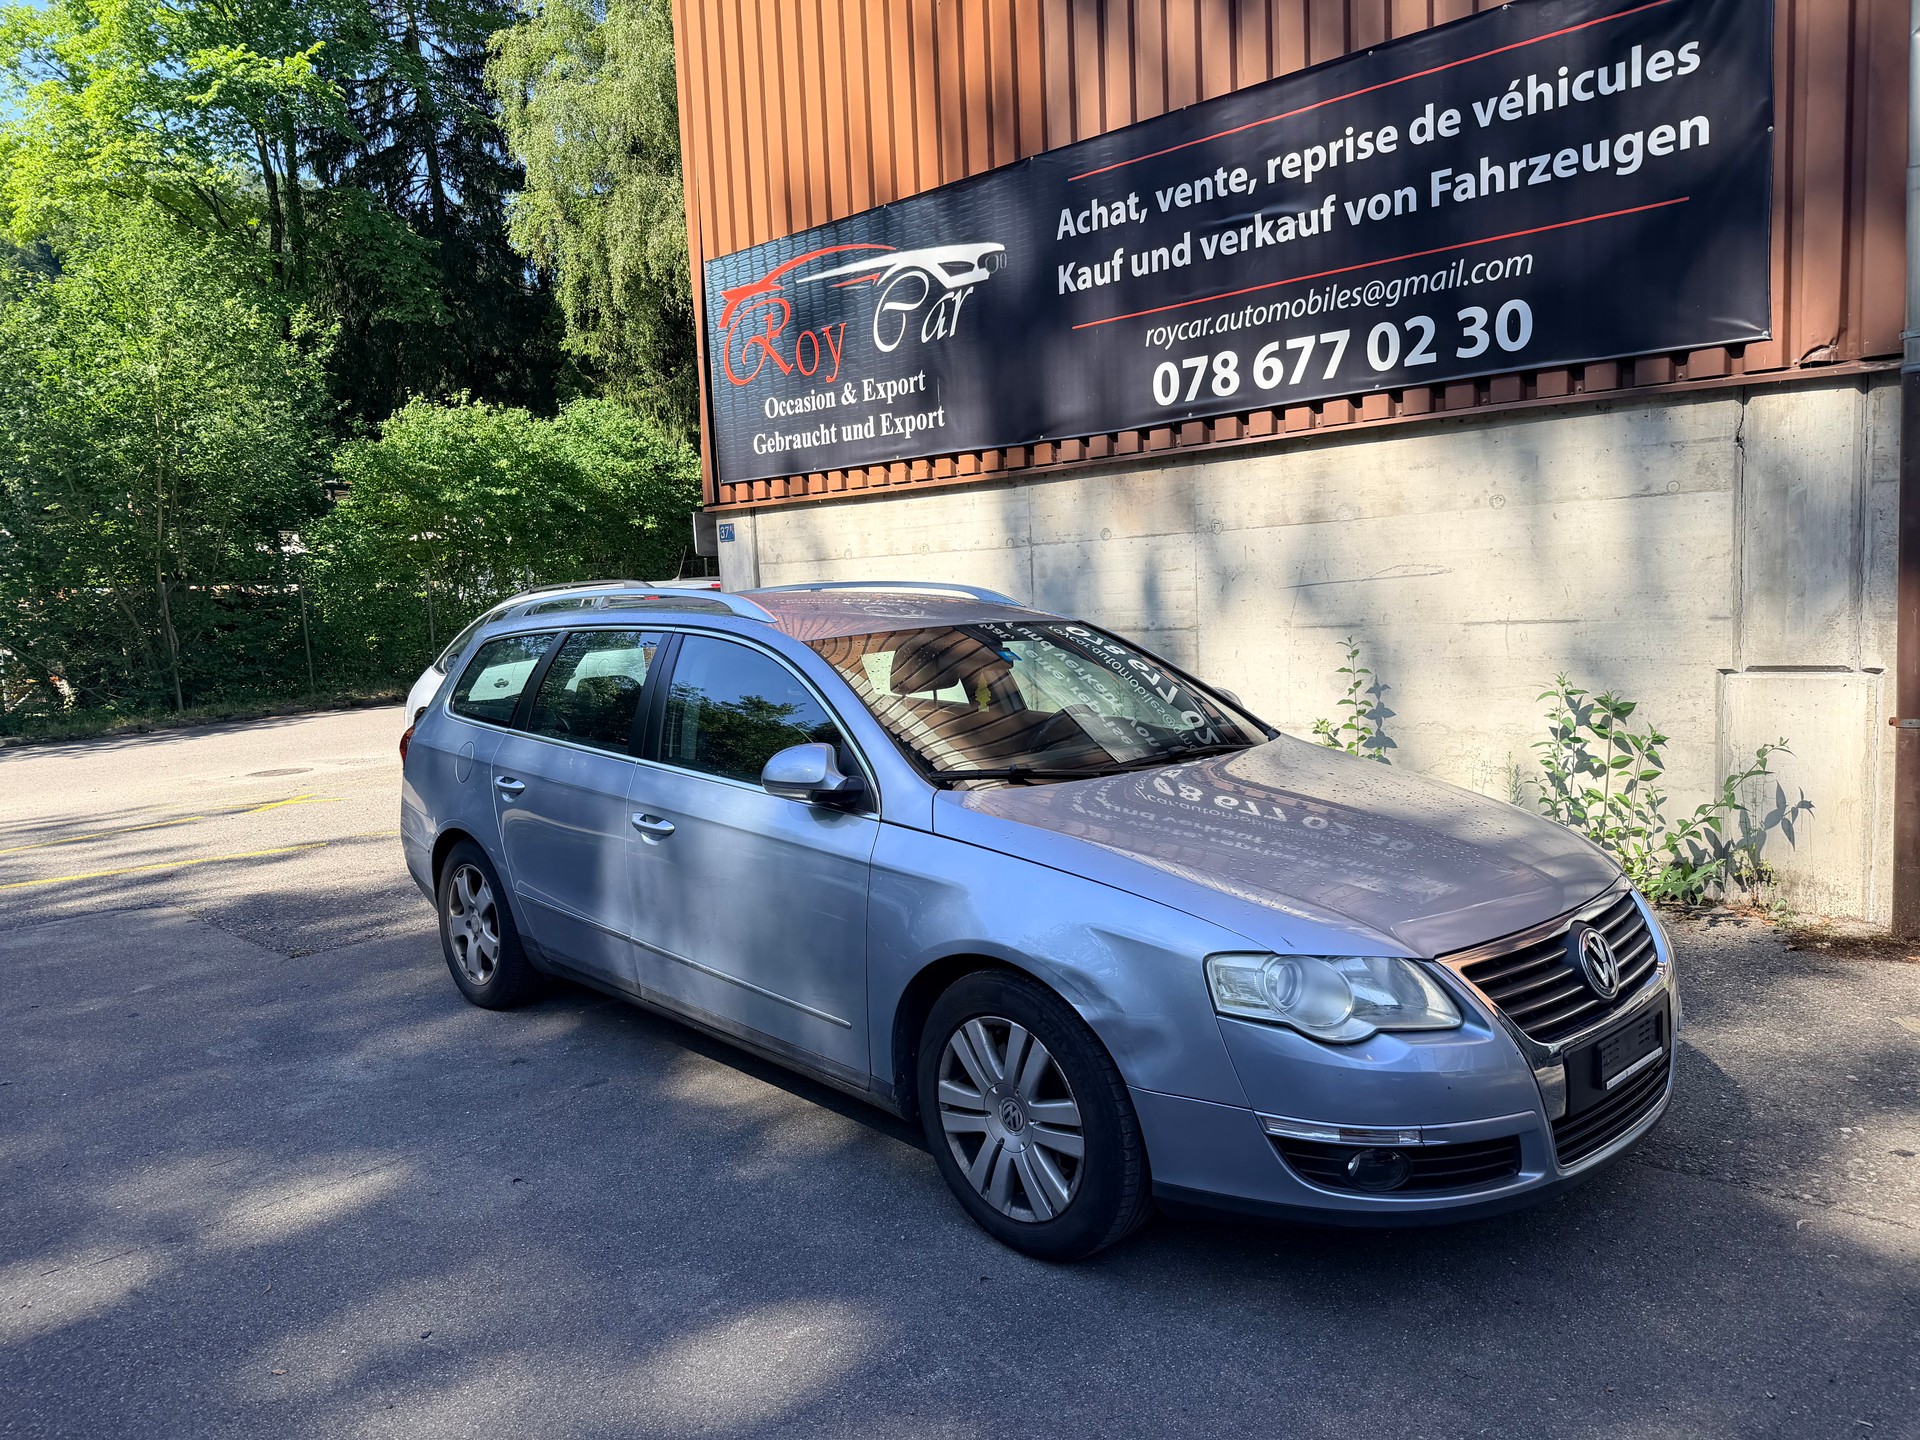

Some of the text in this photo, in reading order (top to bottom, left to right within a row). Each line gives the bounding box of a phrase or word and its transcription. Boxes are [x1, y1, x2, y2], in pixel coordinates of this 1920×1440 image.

[1056, 41, 1701, 241] Achat, vente, reprise de véhicules
[1057, 115, 1711, 295] Kauf und verkauf von Fahrzeugen
[723, 270, 974, 386] Roy Car
[1145, 253, 1533, 351] roycar.automobiles@gmail.com
[1152, 299, 1533, 407] 078 677 02 30
[753, 405, 945, 456] Gebraucht und Export
[764, 369, 926, 419] Occasion & Export
